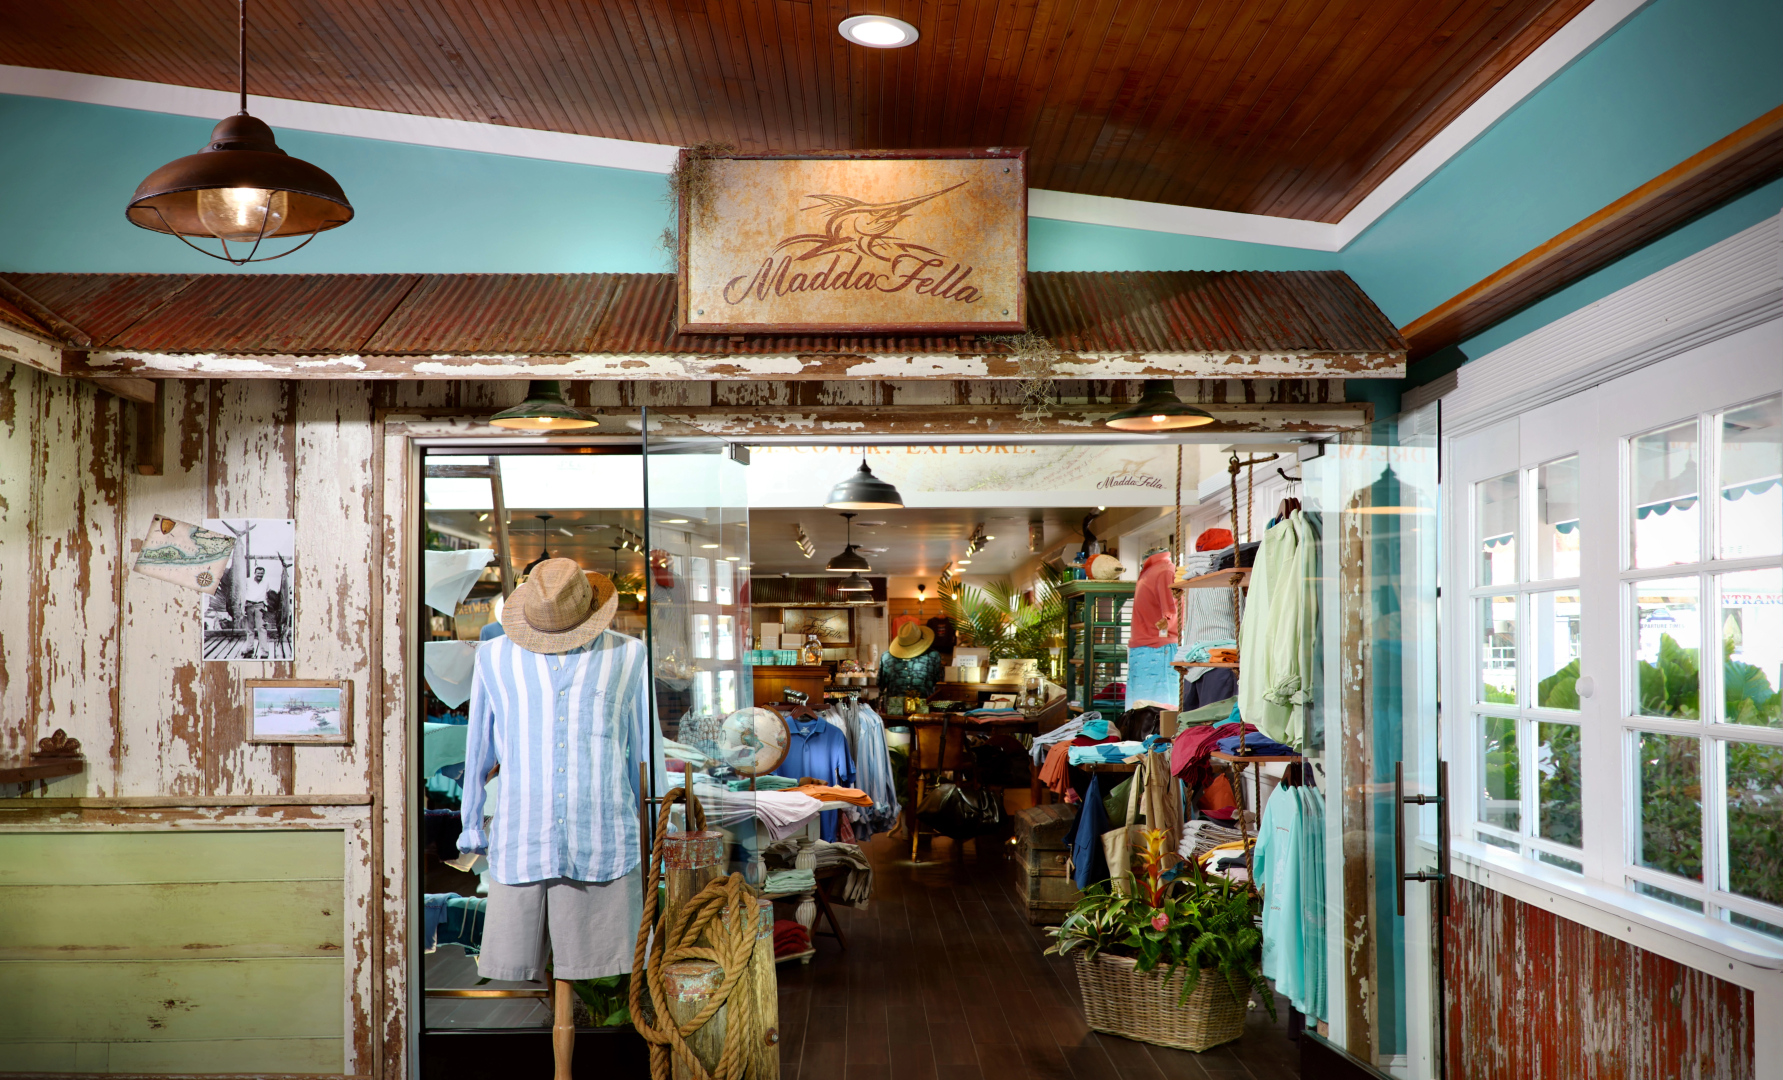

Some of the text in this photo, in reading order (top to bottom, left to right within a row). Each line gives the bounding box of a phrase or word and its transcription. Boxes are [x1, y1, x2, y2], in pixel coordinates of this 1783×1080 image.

[723, 253, 982, 305] MaddaFella
[1096, 475, 1163, 490] MaddaFella
[1722, 595, 1783, 605] NTRANC
[472, 601, 490, 613] WES
